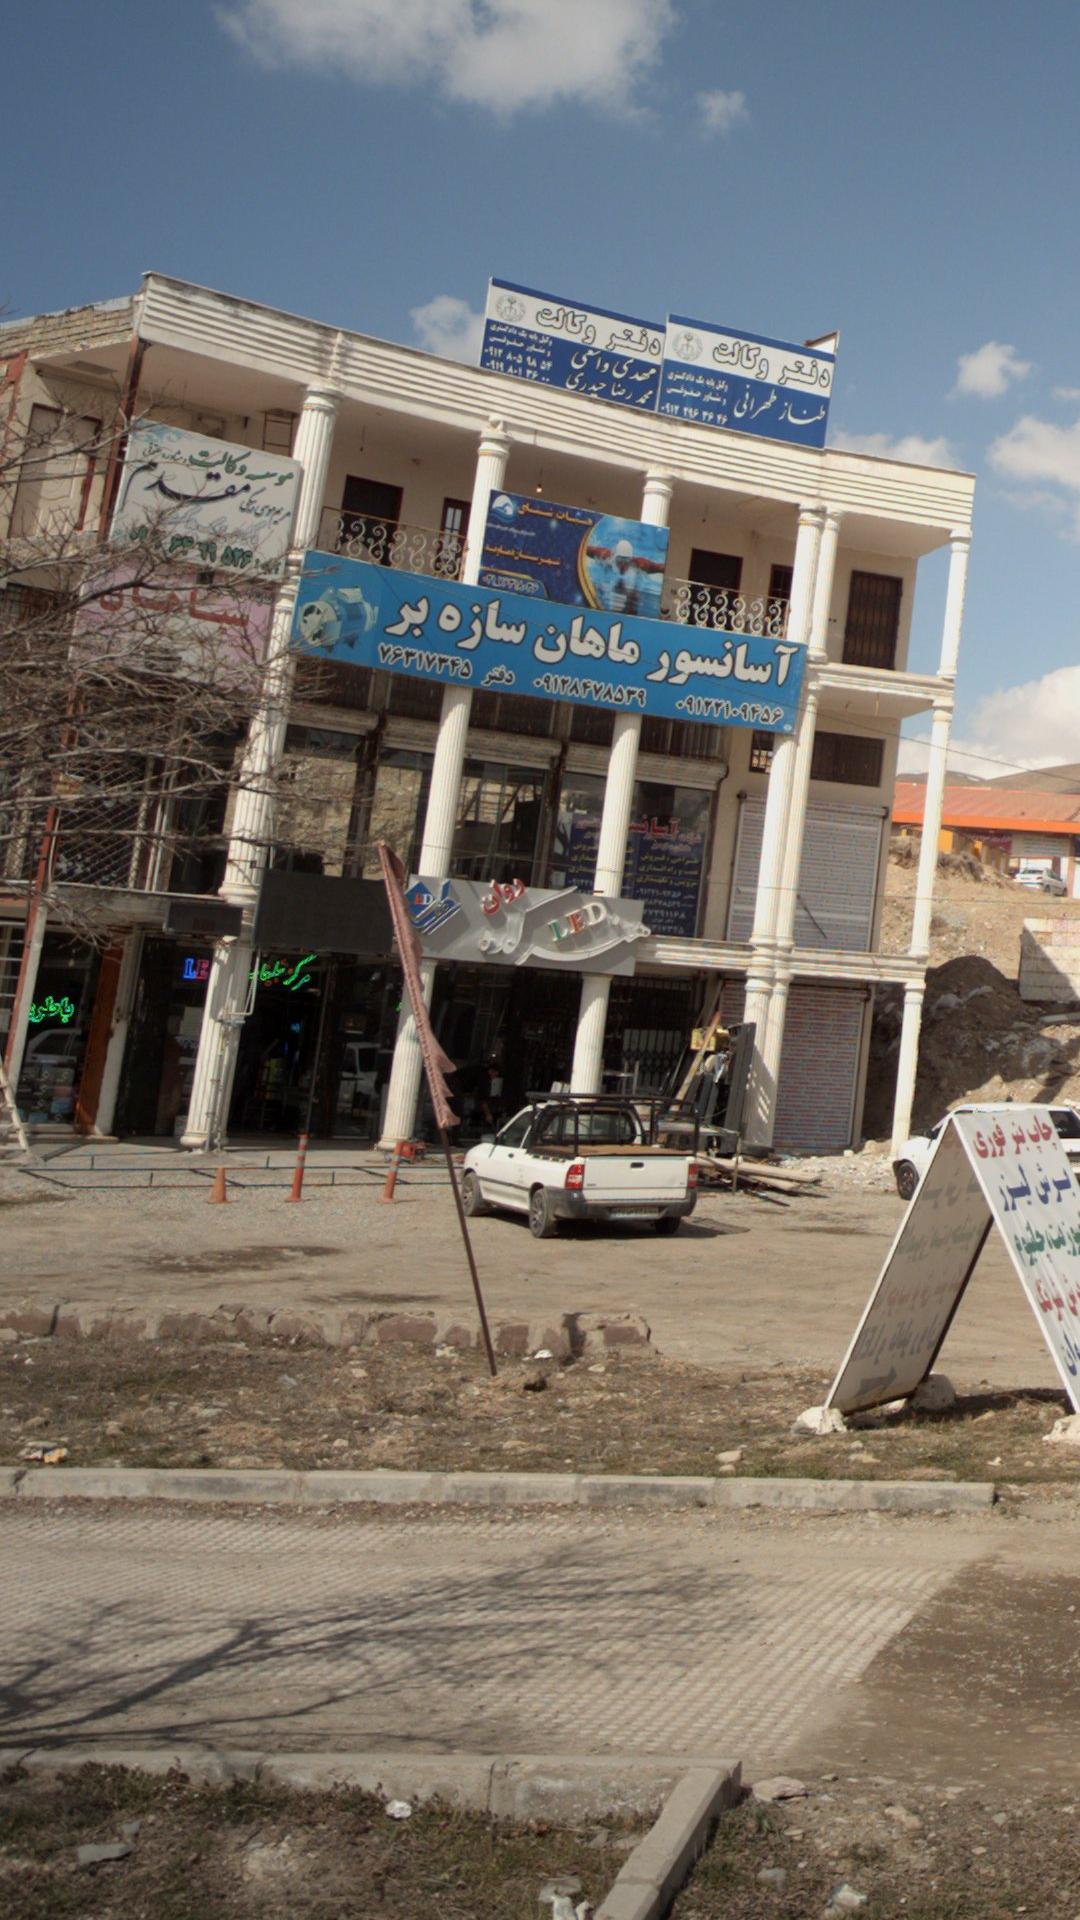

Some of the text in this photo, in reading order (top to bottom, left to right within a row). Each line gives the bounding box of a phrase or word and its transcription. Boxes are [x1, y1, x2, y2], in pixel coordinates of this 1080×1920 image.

[536, 307, 661, 356] دفتر وکالت
[712, 341, 831, 389] دفتر وکالت
[189, 450, 253, 477] وکالت
[378, 642, 472, 679] ۷۶۳۱۷۳۴۵
[384, 596, 799, 687] آسانسور ماهان سازه بر
[481, 664, 516, 687] دفتر
[547, 901, 608, 942] LED
[973, 1114, 1058, 1159] چاپ بنر فوری
[999, 1163, 1032, 1212] لیزر
[1036, 1162, 1077, 1206] برش
